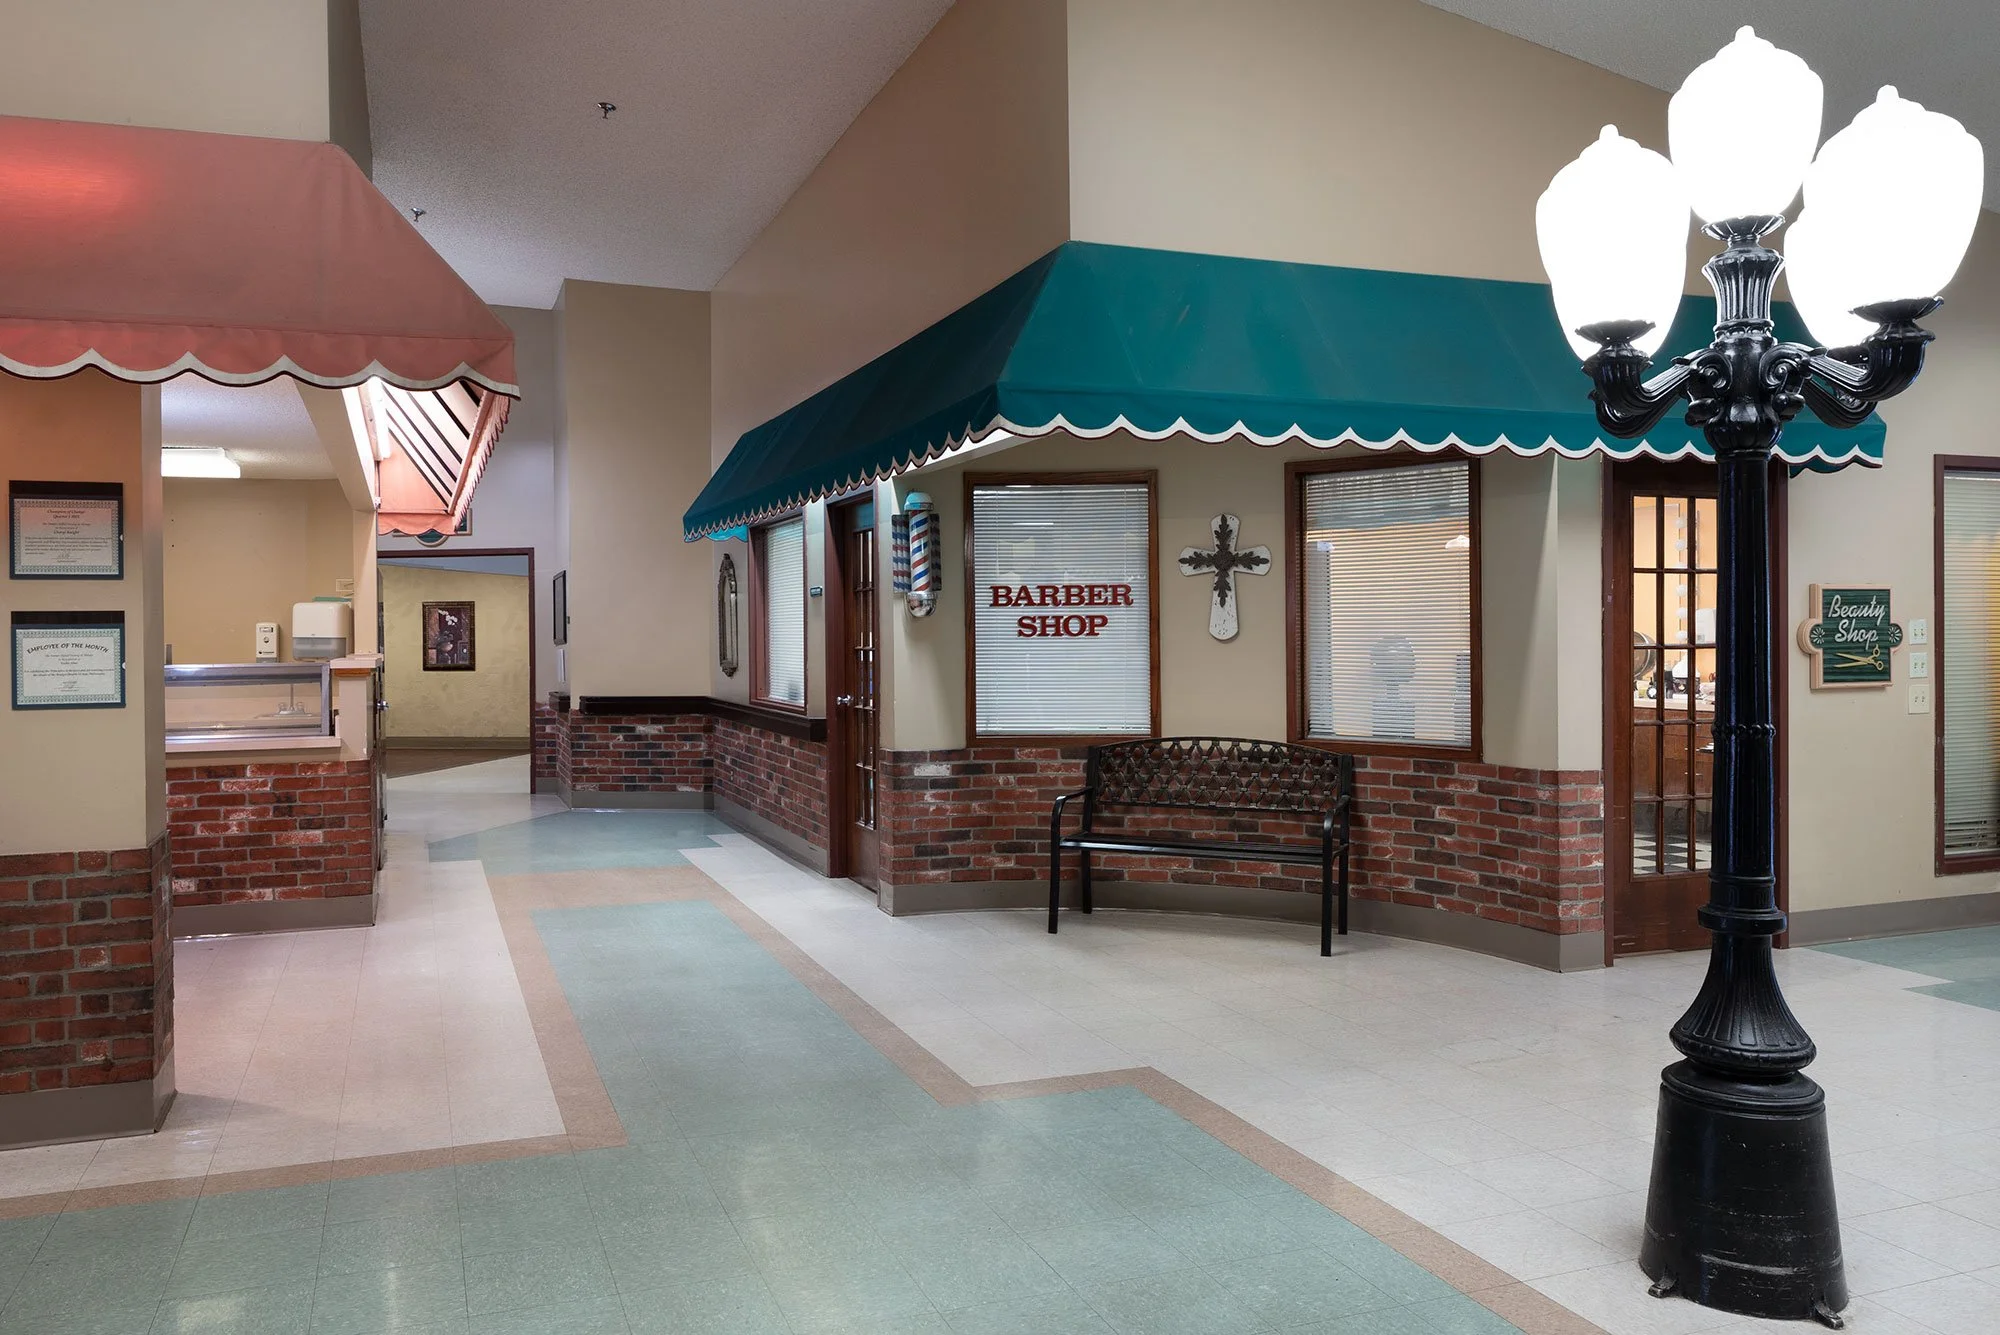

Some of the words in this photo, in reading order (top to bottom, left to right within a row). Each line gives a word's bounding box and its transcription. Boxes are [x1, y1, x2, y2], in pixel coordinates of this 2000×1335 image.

[989, 584, 1134, 607] BARBER
[1828, 594, 1886, 626] Beauty
[1017, 615, 1109, 637] SHOP
[1834, 618, 1879, 651] Shop
[26, 643, 59, 654] EMPLOYEE
[84, 643, 109, 653] MONTH
